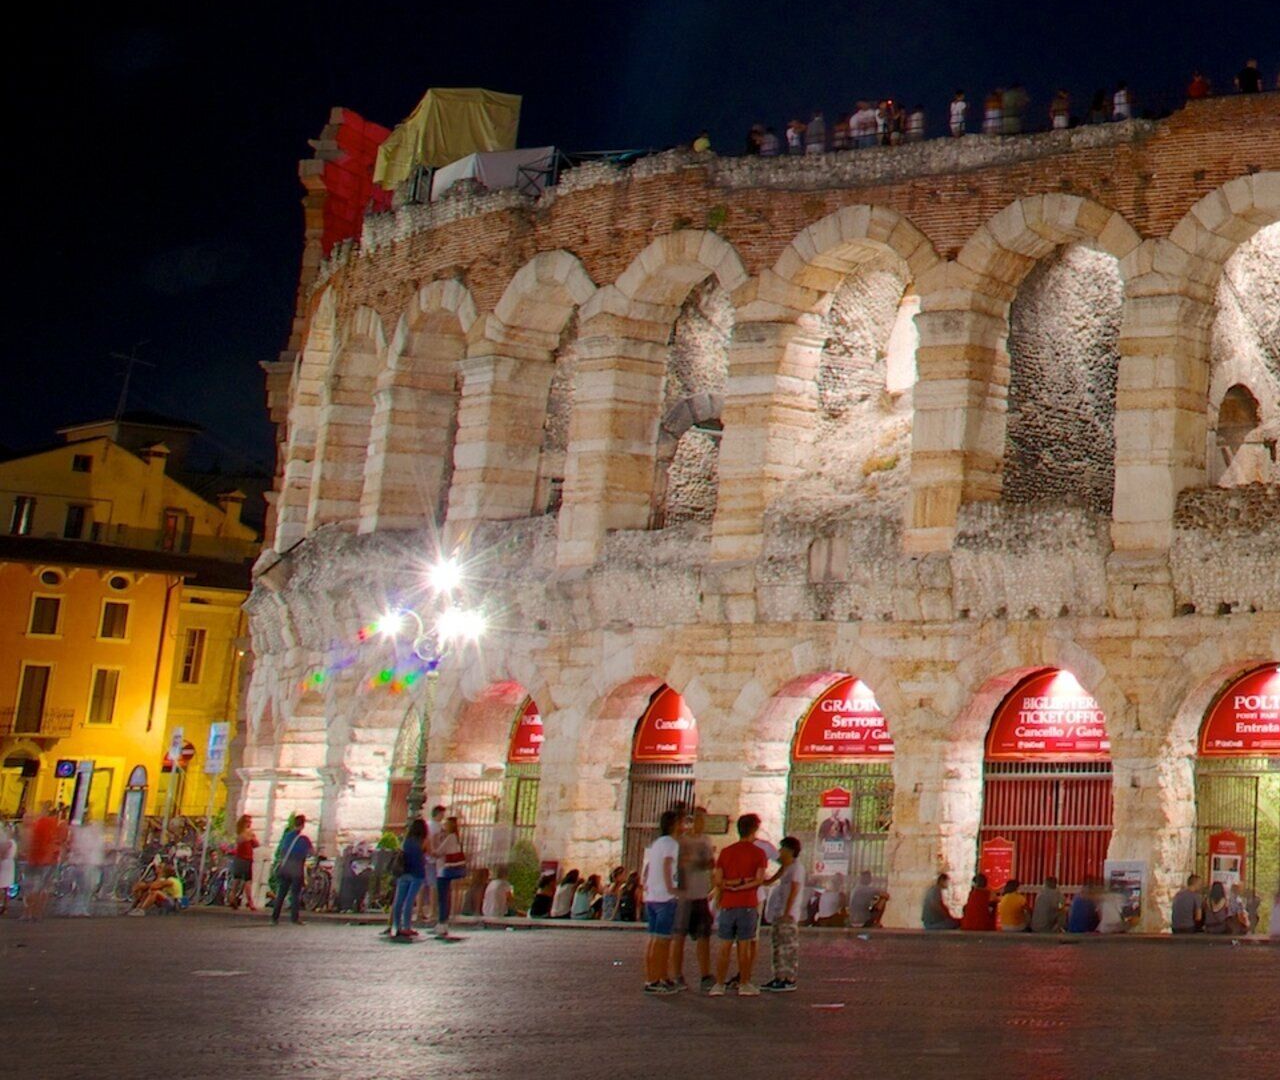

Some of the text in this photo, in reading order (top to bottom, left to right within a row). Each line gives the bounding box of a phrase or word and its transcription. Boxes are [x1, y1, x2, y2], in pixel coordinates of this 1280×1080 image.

[1019, 710, 1106, 723] TICKET OFFIC
[1015, 726, 1064, 737] Cancello
[1076, 726, 1103, 737] Gate
[1236, 722, 1280, 733] Entrata
[824, 730, 860, 740] Entrata
